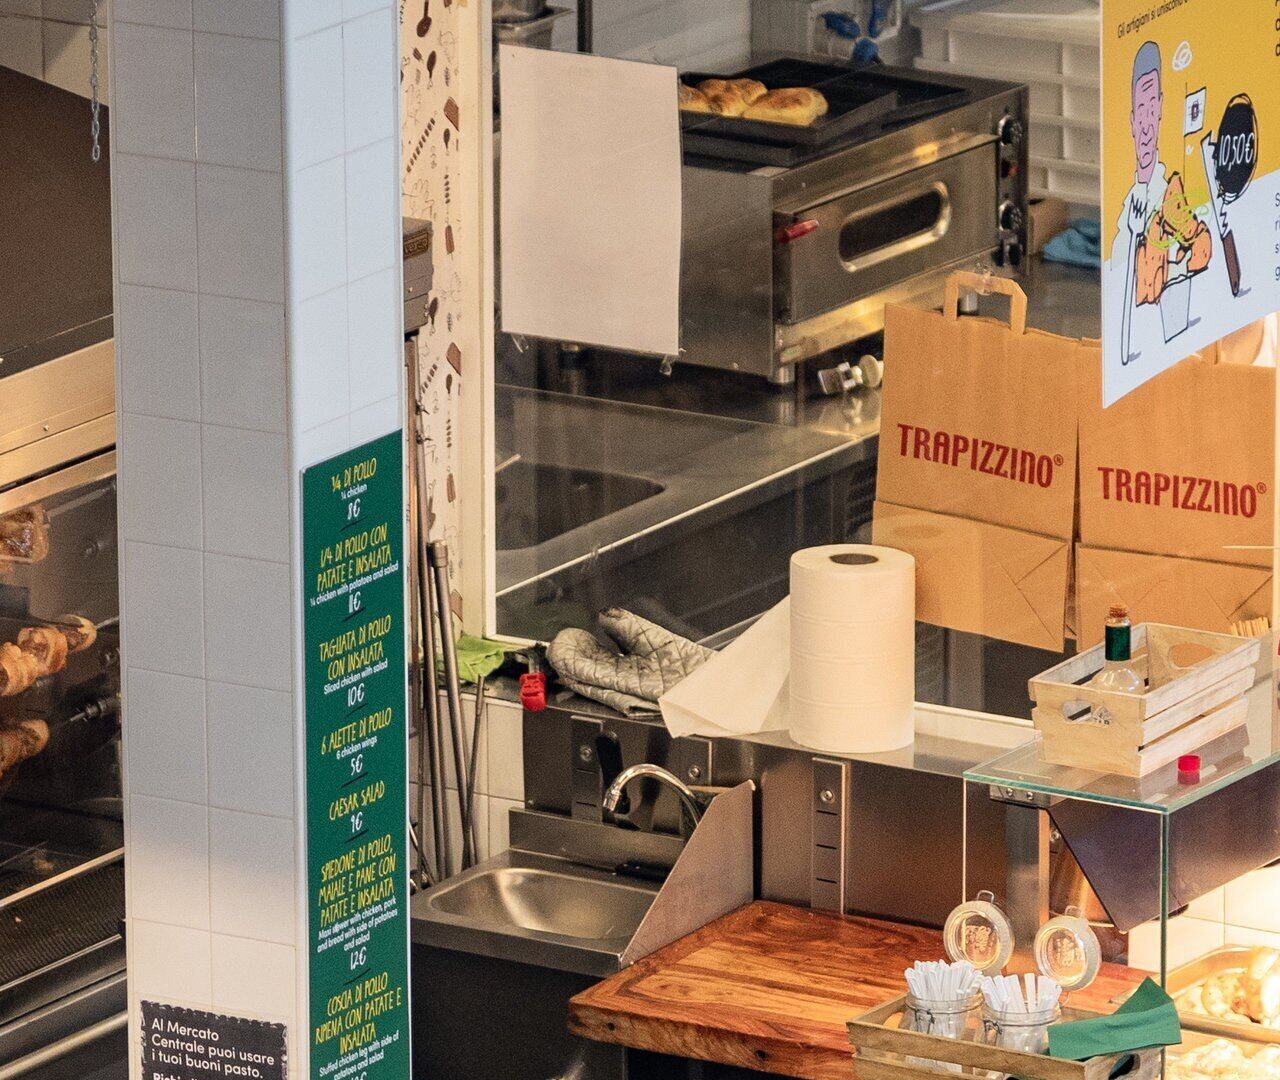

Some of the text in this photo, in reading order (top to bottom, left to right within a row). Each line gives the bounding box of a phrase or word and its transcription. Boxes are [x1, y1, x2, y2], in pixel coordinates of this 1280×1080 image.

[1219, 130, 1255, 171] 10,50€
[344, 458, 376, 487] DI POLLO
[336, 522, 387, 561] DI POLLO CON
[317, 544, 391, 592] PATATE E INSALATA
[319, 614, 392, 662] TAGLIATA DI POLLO
[328, 641, 384, 680] CON INSALATA
[347, 683, 365, 707] 10€
[328, 707, 392, 753] ALETTE DI POLLO
[329, 780, 385, 820] CAESAR SALAD
[321, 834, 393, 882] SPIEDONE DI POLLO,
[318, 853, 396, 906] MAIALE E PANE CON
[320, 877, 394, 927] PATATE E INSALATA
[350, 946, 366, 970] 12€
[327, 972, 388, 1016] COSCIA DI POLLO
[152, 1017, 219, 1041] Al Mercato
[316, 987, 402, 1045] RIPIENA CON PATATE E
[152, 1034, 275, 1066] Centrale puoi usare
[340, 1022, 376, 1055] INSALATA
[152, 1049, 263, 1079] i tuoi buoni pasto.
